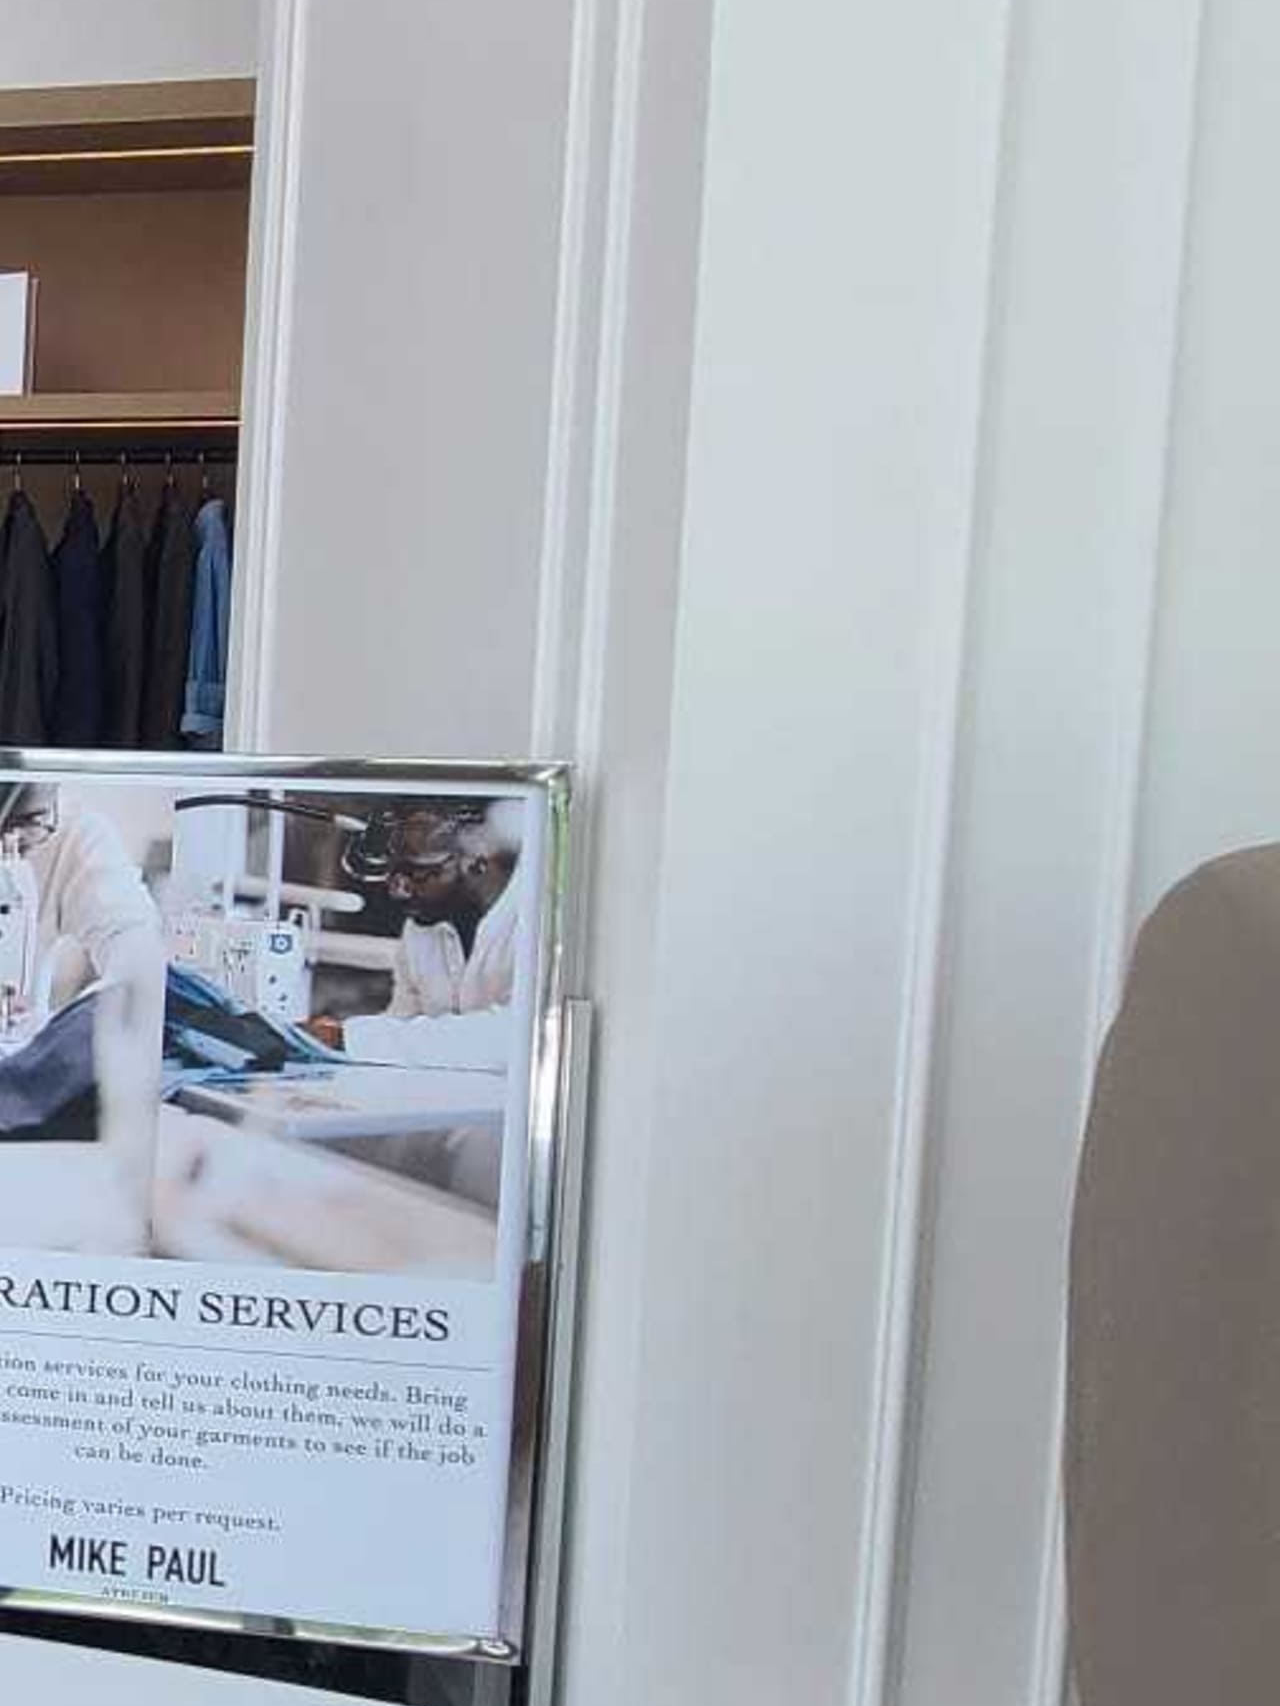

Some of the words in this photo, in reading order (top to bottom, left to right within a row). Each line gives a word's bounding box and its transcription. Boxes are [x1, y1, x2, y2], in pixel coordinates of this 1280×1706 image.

[198, 1290, 450, 1342] SERVICES
[6, 1381, 61, 1401] come
[67, 1385, 88, 1402] in
[94, 1388, 135, 1410] and
[141, 1392, 174, 1412] tell
[182, 1400, 207, 1415] us
[212, 1396, 274, 1420] about
[351, 1416, 383, 1430] we
[390, 1410, 431, 1434] will
[438, 1416, 466, 1438] do
[472, 1424, 486, 1439] a
[43, 1362, 129, 1380] services
[135, 1363, 164, 1383] for
[173, 1370, 224, 1389] your
[230, 1371, 319, 1402] clothing
[326, 1384, 397, 1403] needs.
[405, 1385, 468, 1412] Bring
[74, 1445, 111, 1461] can
[118, 1442, 144, 1465] be
[151, 1446, 208, 1470] done.
[111, 1413, 133, 1436] of
[137, 1421, 188, 1441] your
[195, 1424, 297, 1451] garments
[303, 1431, 326, 1453] to
[333, 1440, 368, 1458] see
[373, 1434, 394, 1460] if
[397, 1439, 432, 1462] the
[438, 1444, 476, 1468] job
[0, 1483, 76, 1515] Pricing
[82, 1498, 144, 1518] varies
[152, 1506, 189, 1525] per
[195, 1511, 282, 1534] request.
[49, 1533, 128, 1577] MIKE
[146, 1544, 226, 1588] PAUL
